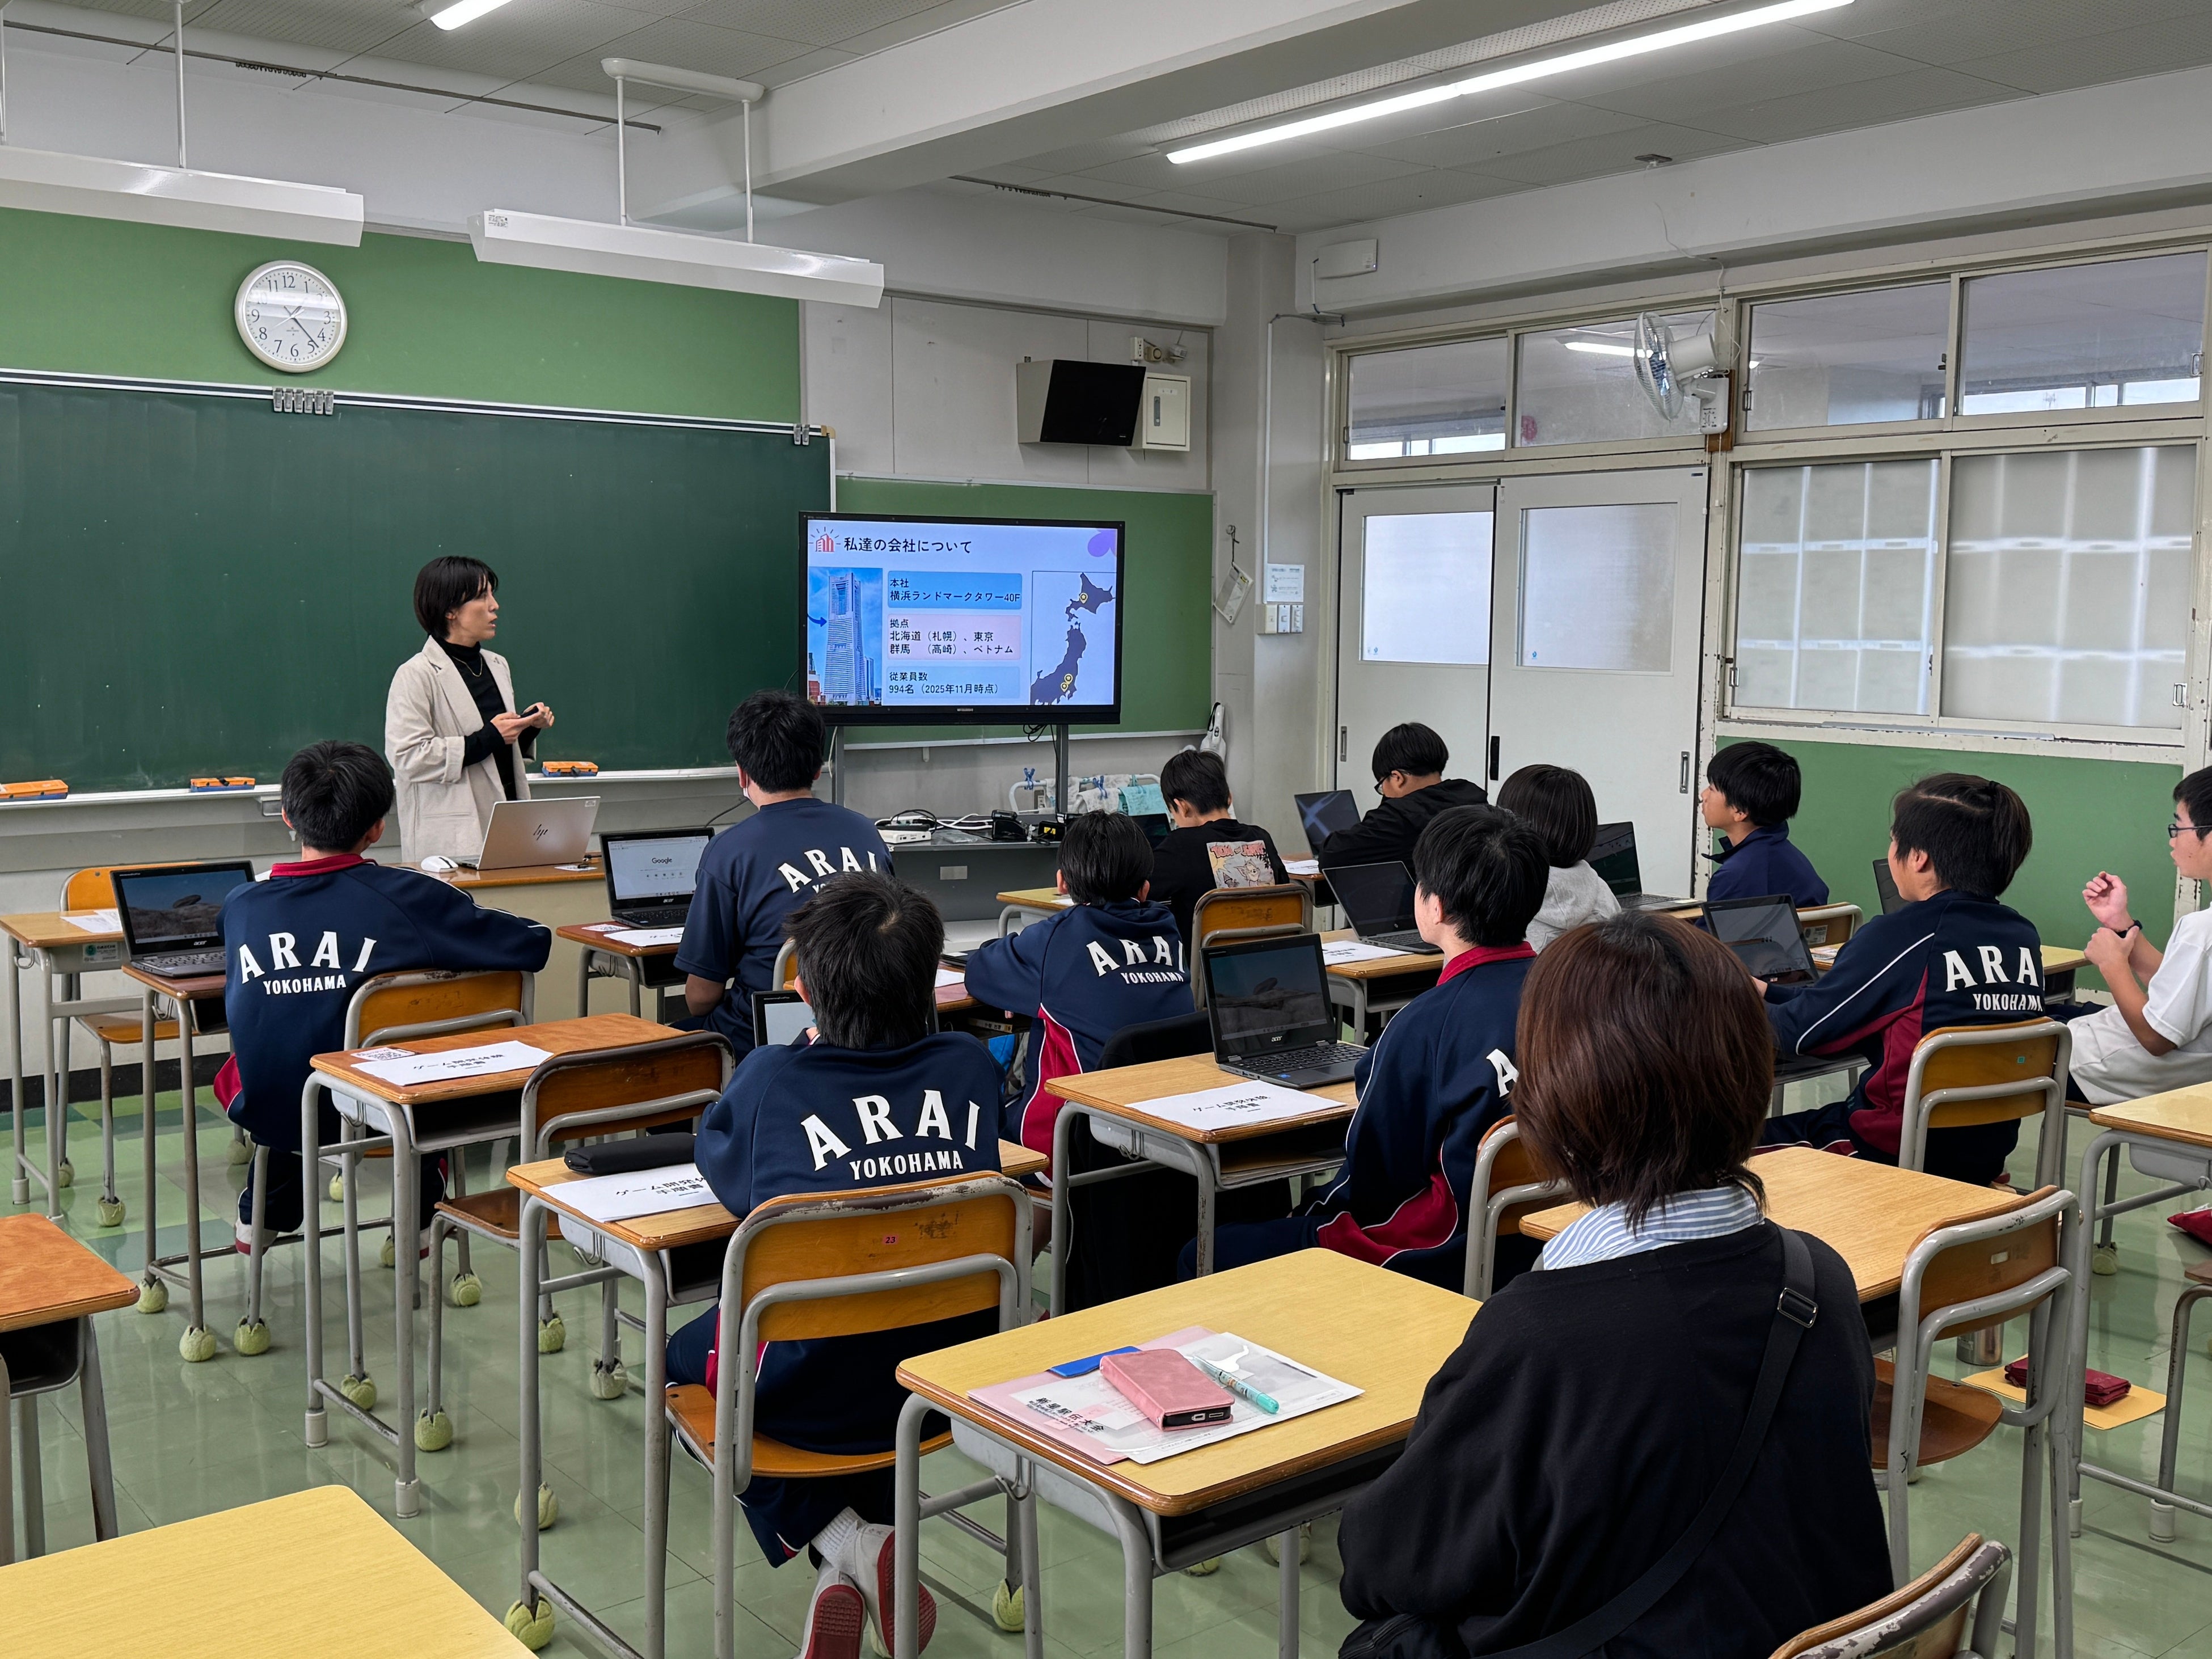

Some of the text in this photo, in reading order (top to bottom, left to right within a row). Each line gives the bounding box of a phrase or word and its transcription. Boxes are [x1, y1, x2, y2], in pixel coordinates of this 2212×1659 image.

[268, 280, 278, 292] 11
[282, 275, 296, 288] 12
[304, 281, 309, 293] 1
[251, 309, 260, 323] 9
[323, 310, 331, 324] 3
[259, 327, 267, 340] 8
[317, 328, 326, 341] 4
[274, 340, 282, 353] 7
[290, 343, 299, 357] 6
[307, 340, 315, 354] 5
[844, 537, 972, 554] 私達の会社について
[890, 578, 909, 588] 本社
[890, 590, 1020, 602] 横浜ランドマークタワー40F
[890, 619, 909, 628] 拠点
[889, 672, 928, 682] 従業員数
[778, 847, 877, 893] ARAI
[239, 931, 377, 984] ARAI
[1086, 936, 1185, 977] ARAI
[1943, 945, 2045, 992] ARA
[263, 974, 347, 995] YOKOHAMA
[1120, 972, 1184, 984] YOKOHAMA
[800, 1090, 980, 1171] ARAI
[849, 1150, 964, 1180] YOKOHAMA
